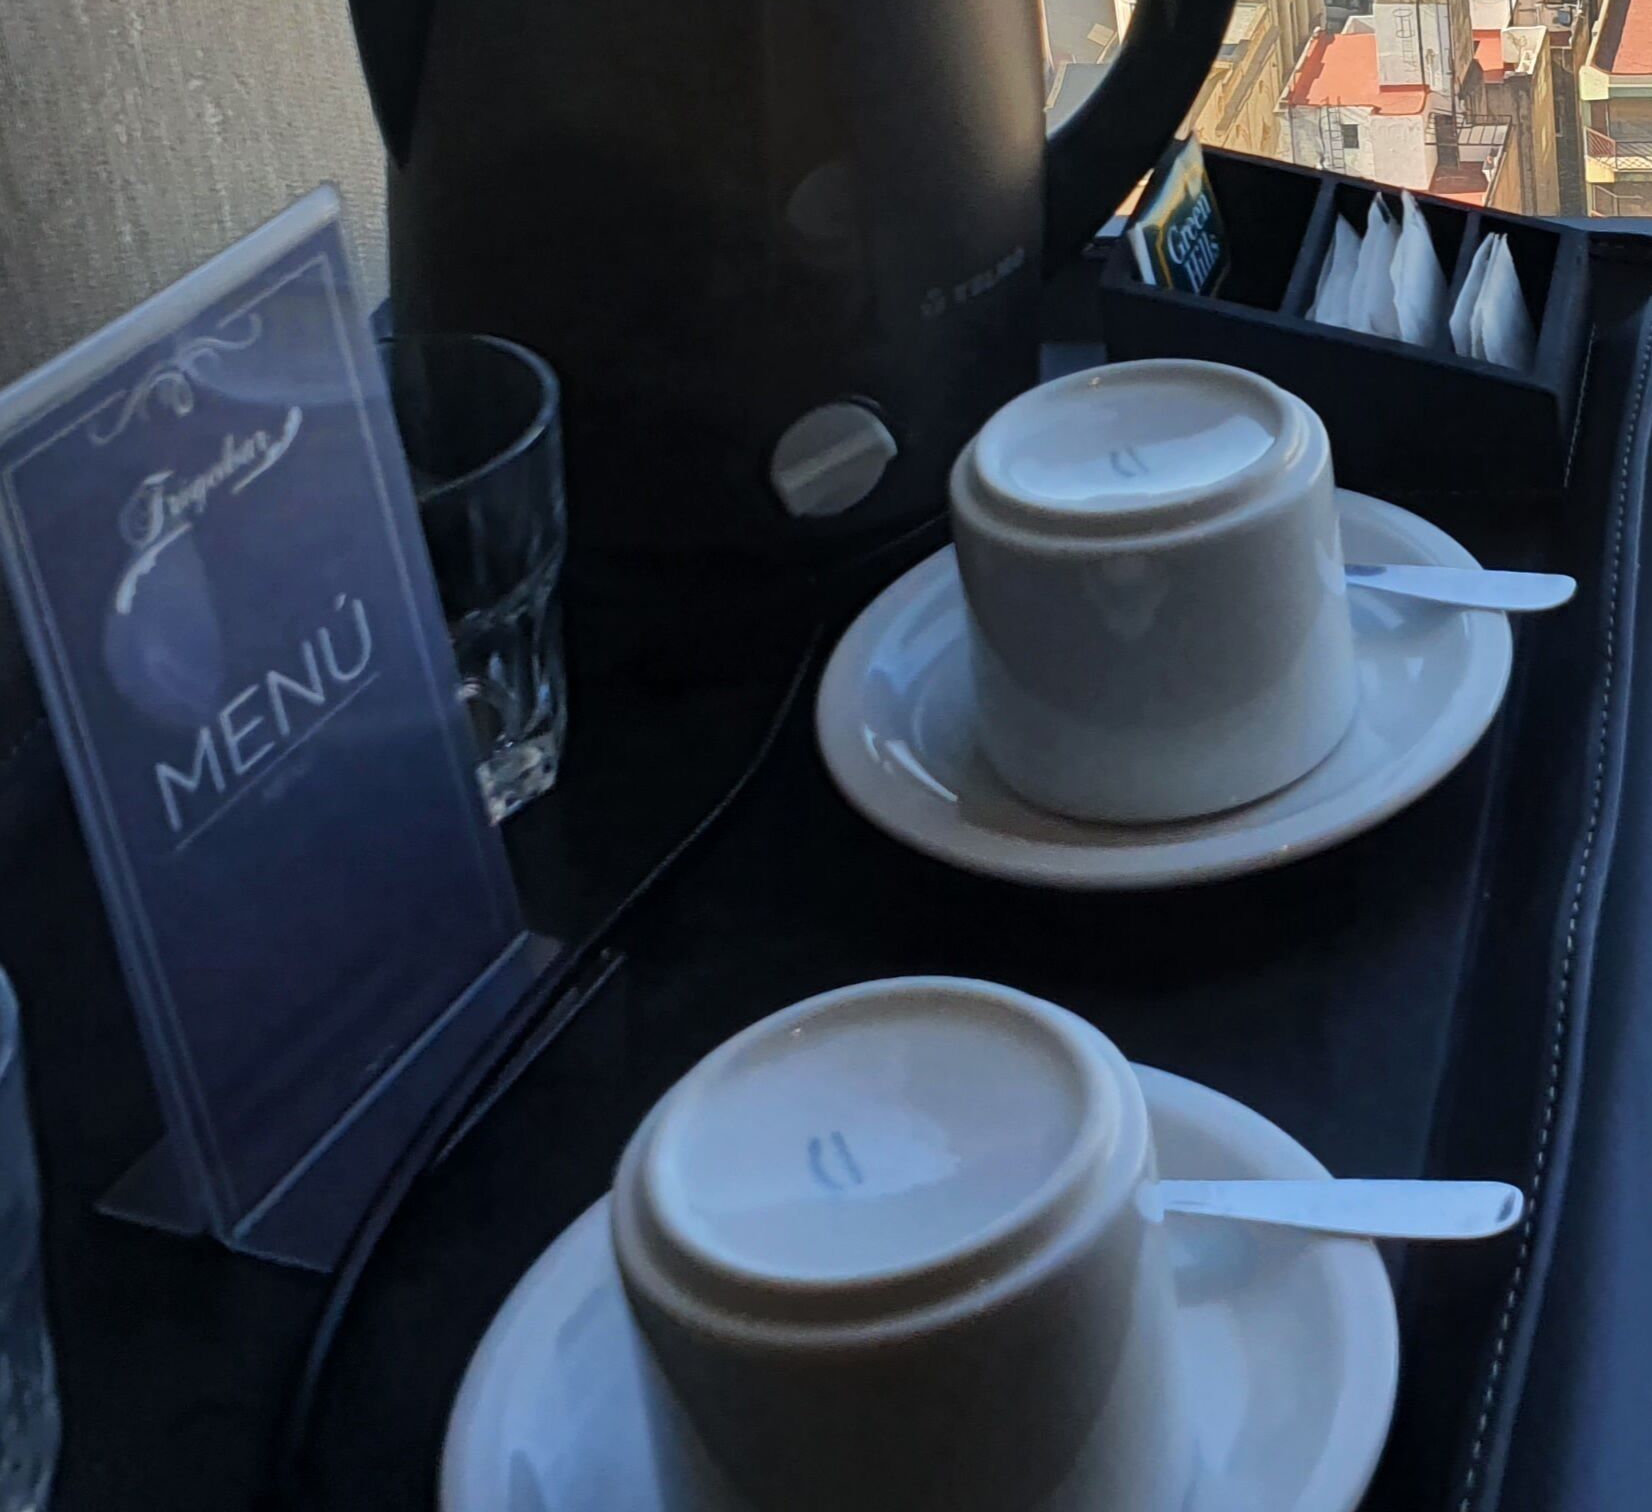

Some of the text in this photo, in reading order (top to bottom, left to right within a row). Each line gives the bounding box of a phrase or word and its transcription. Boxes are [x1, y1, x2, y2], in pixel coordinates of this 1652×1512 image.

[1167, 193, 1212, 265] Green
[1184, 231, 1220, 294] Hills
[154, 592, 372, 832] MENÚ
